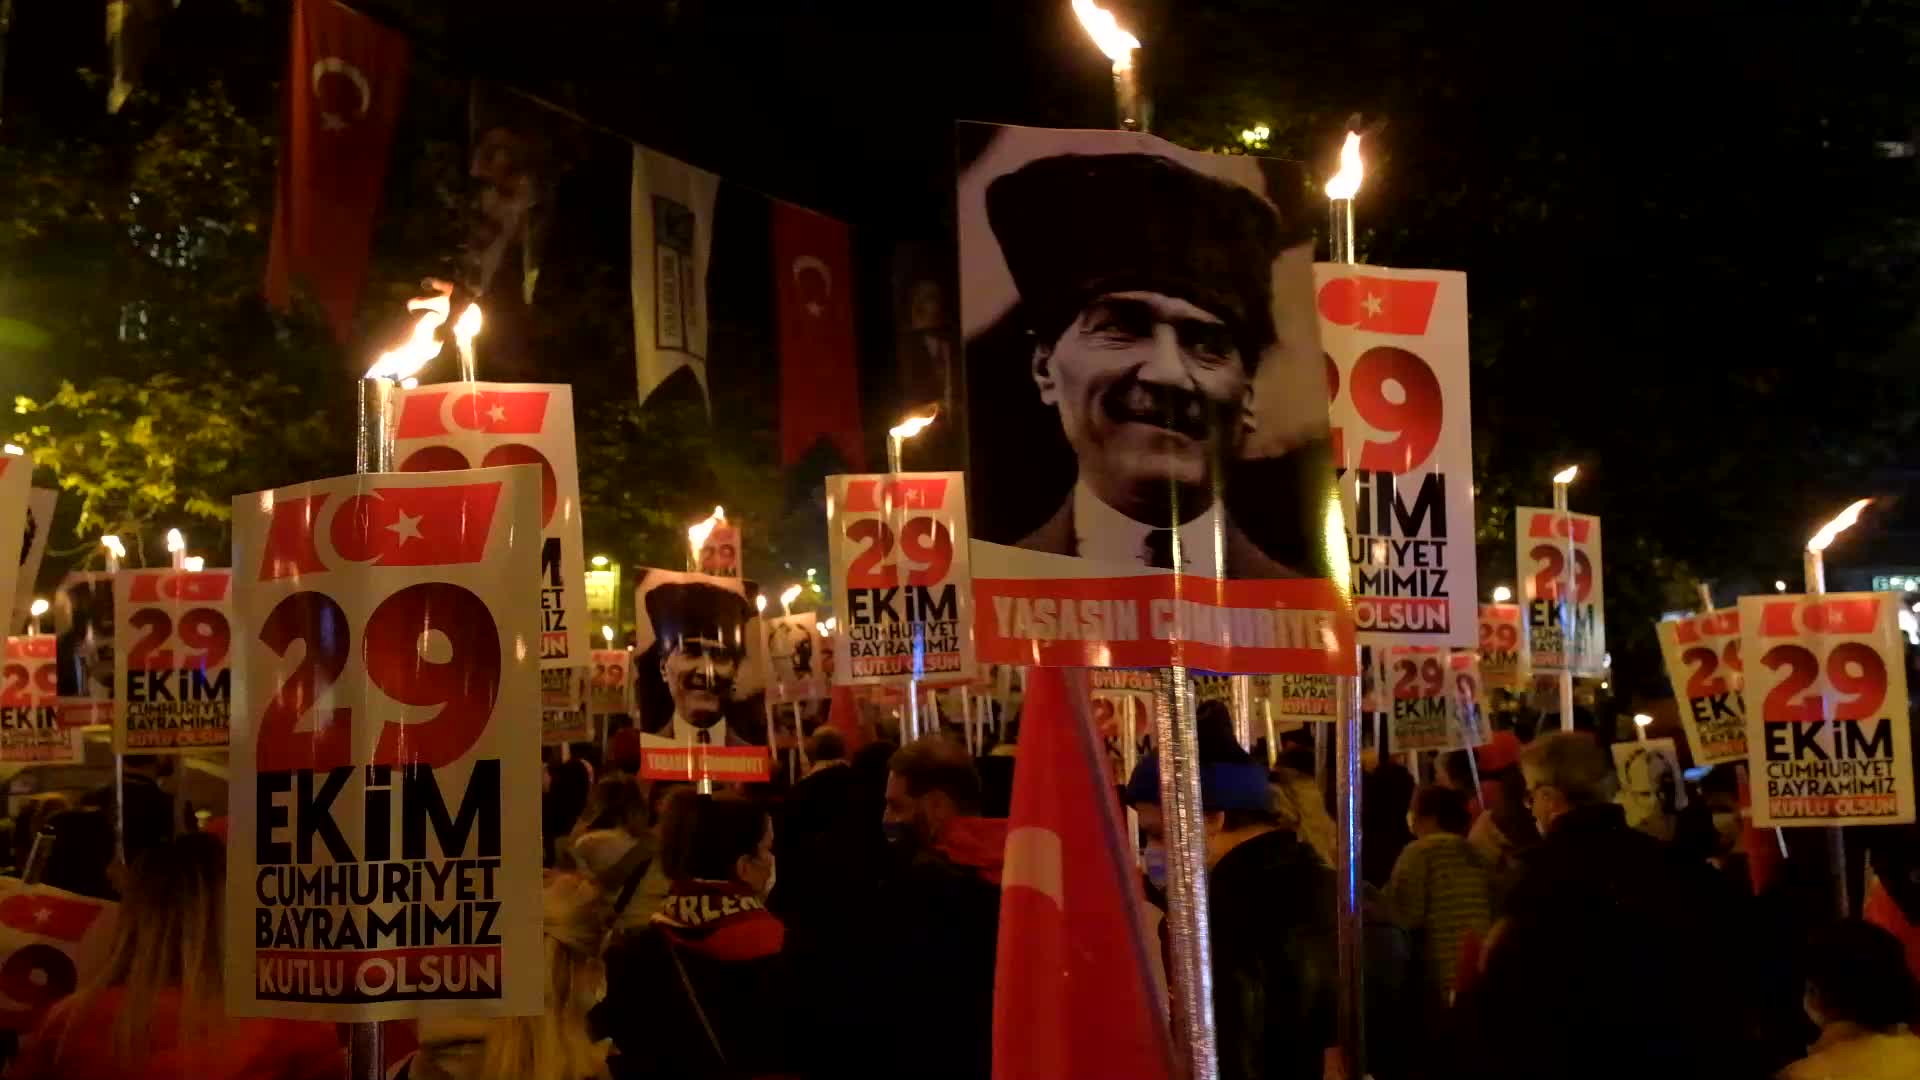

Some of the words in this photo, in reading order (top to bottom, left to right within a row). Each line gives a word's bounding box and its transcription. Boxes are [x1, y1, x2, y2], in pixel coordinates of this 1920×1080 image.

[1327, 346, 1443, 475] 9
[846, 517, 953, 589] 29
[1529, 544, 1593, 603] 29
[1355, 602, 1447, 627] OLSUN
[1479, 624, 1518, 650] 29
[128, 607, 231, 670] 29
[257, 582, 501, 773] 29
[905, 654, 960, 672] OSUN
[1393, 657, 1444, 699] 29
[1760, 642, 1888, 721] 29
[1768, 777, 1896, 798] BAYRAMIMIZ
[1771, 799, 1829, 817] KUTLU
[1834, 796, 1894, 815] OLSUN
[256, 902, 502, 950] BAYRAMIMIZ
[259, 957, 344, 996] KUTLU
[355, 954, 497, 997] OLSUN
